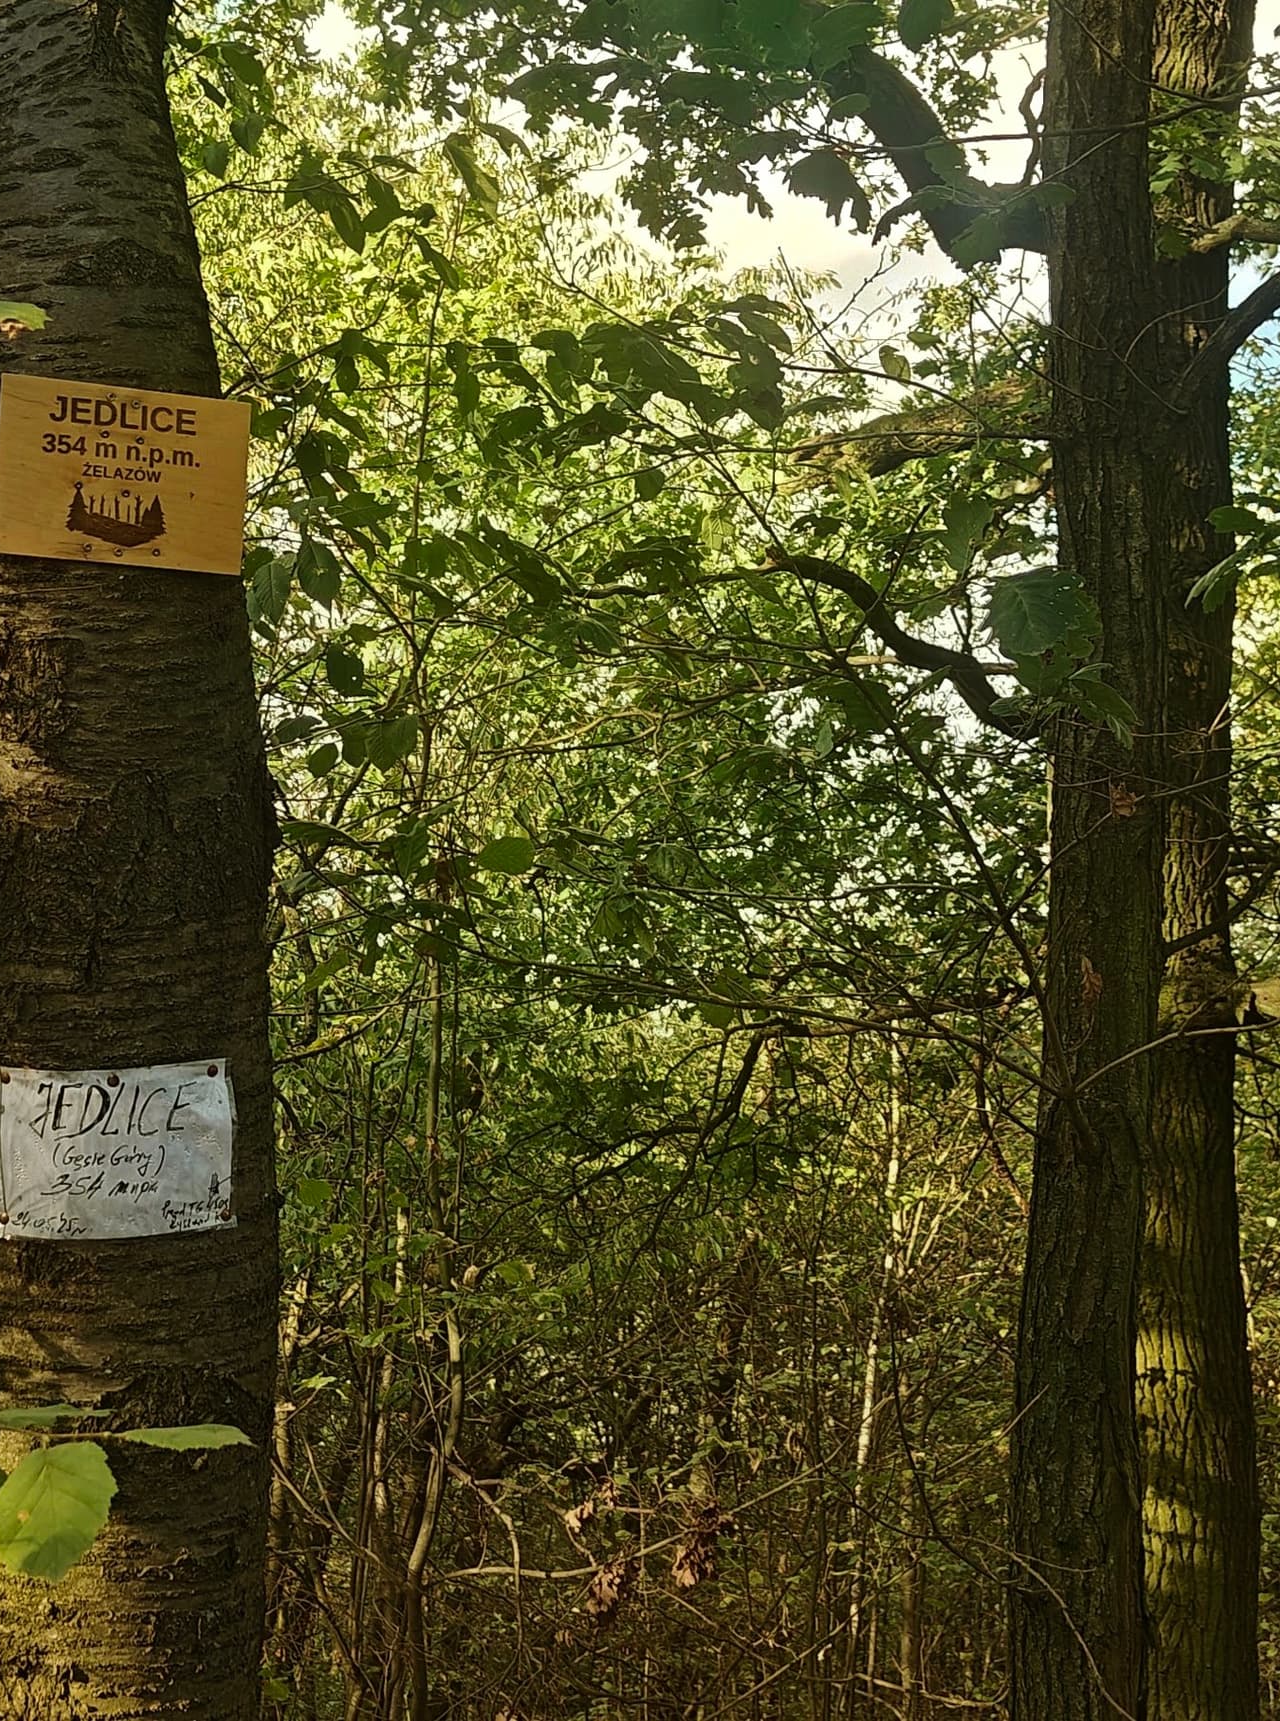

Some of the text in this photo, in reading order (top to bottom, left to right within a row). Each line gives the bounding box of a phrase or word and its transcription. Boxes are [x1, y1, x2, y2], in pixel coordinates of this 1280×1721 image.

[49, 395, 197, 436] JEDLICE
[42, 433, 200, 468] 354 m n.p.m.
[82, 462, 161, 483] ŻELAZÓW
[29, 1080, 197, 1140] JEDLICE
[40, 1170, 105, 1200] 354
